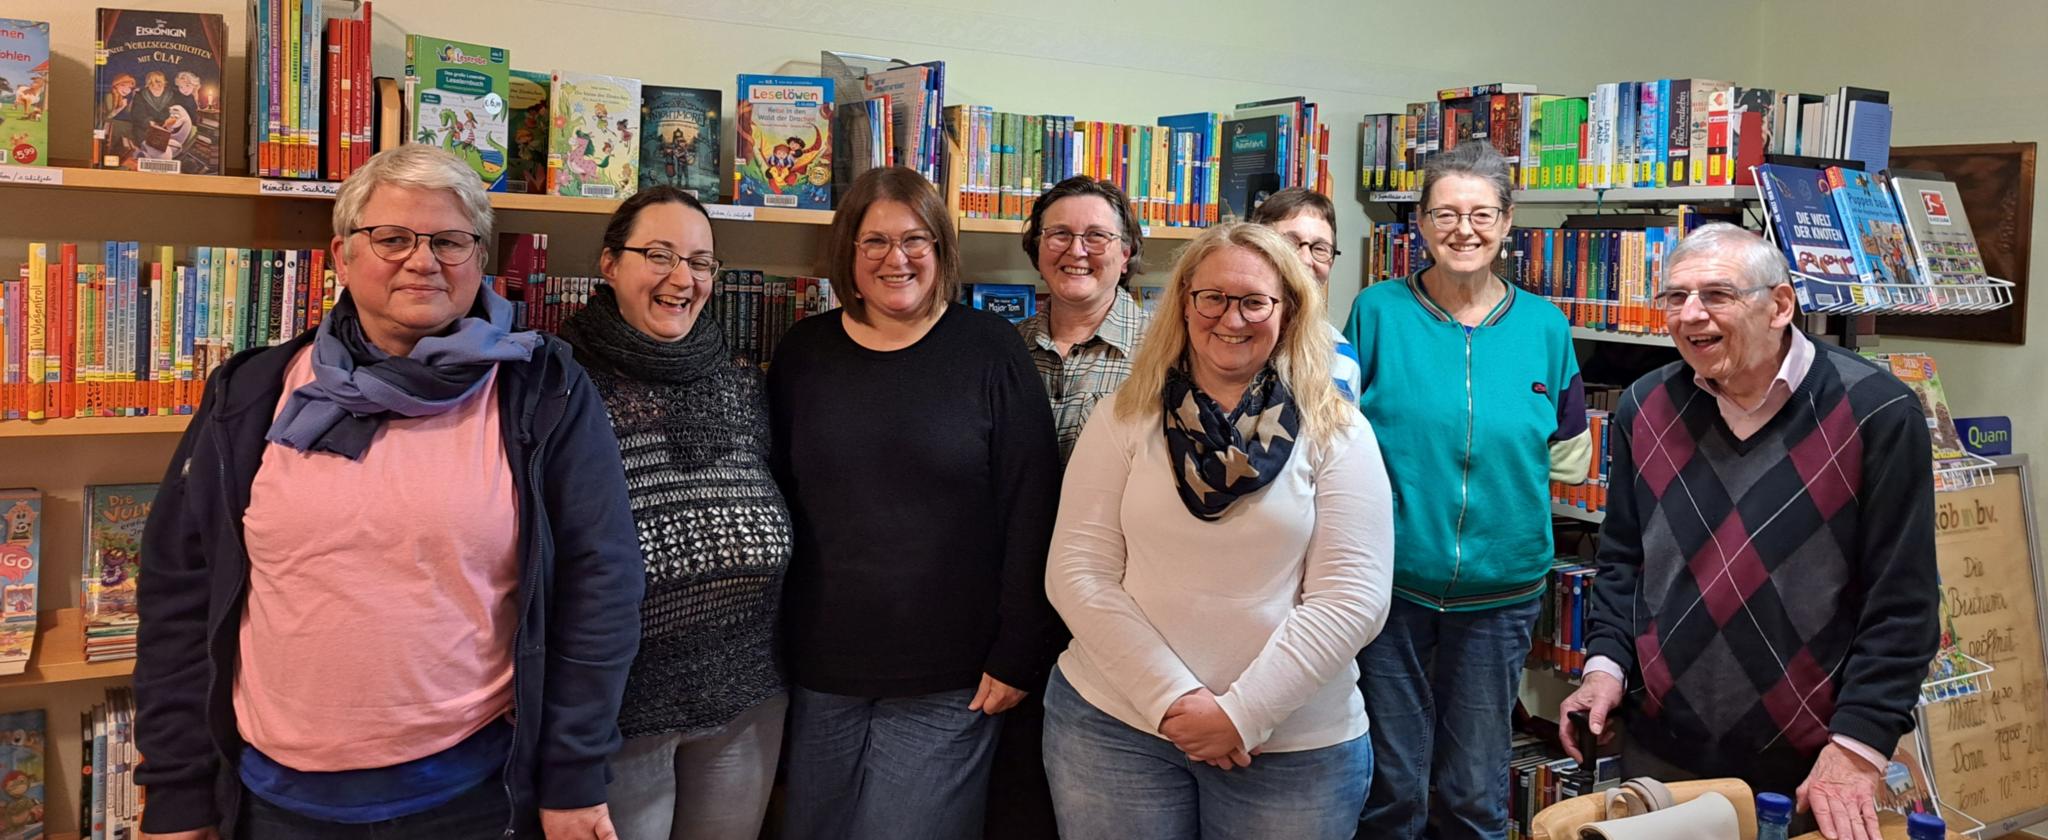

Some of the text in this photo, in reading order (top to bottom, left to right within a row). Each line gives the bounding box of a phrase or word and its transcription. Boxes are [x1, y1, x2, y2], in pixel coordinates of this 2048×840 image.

[753, 87, 818, 101] Leselöwen
[302, 184, 336, 194] Sachbü
[1796, 211, 1832, 228] DIE WELT
[1794, 224, 1843, 242] DER KNOTEN
[988, 302, 1020, 313] Major Tom
[1968, 426, 2008, 448] Quam
[103, 503, 150, 522] VULK
[1963, 556, 1985, 578] Die
